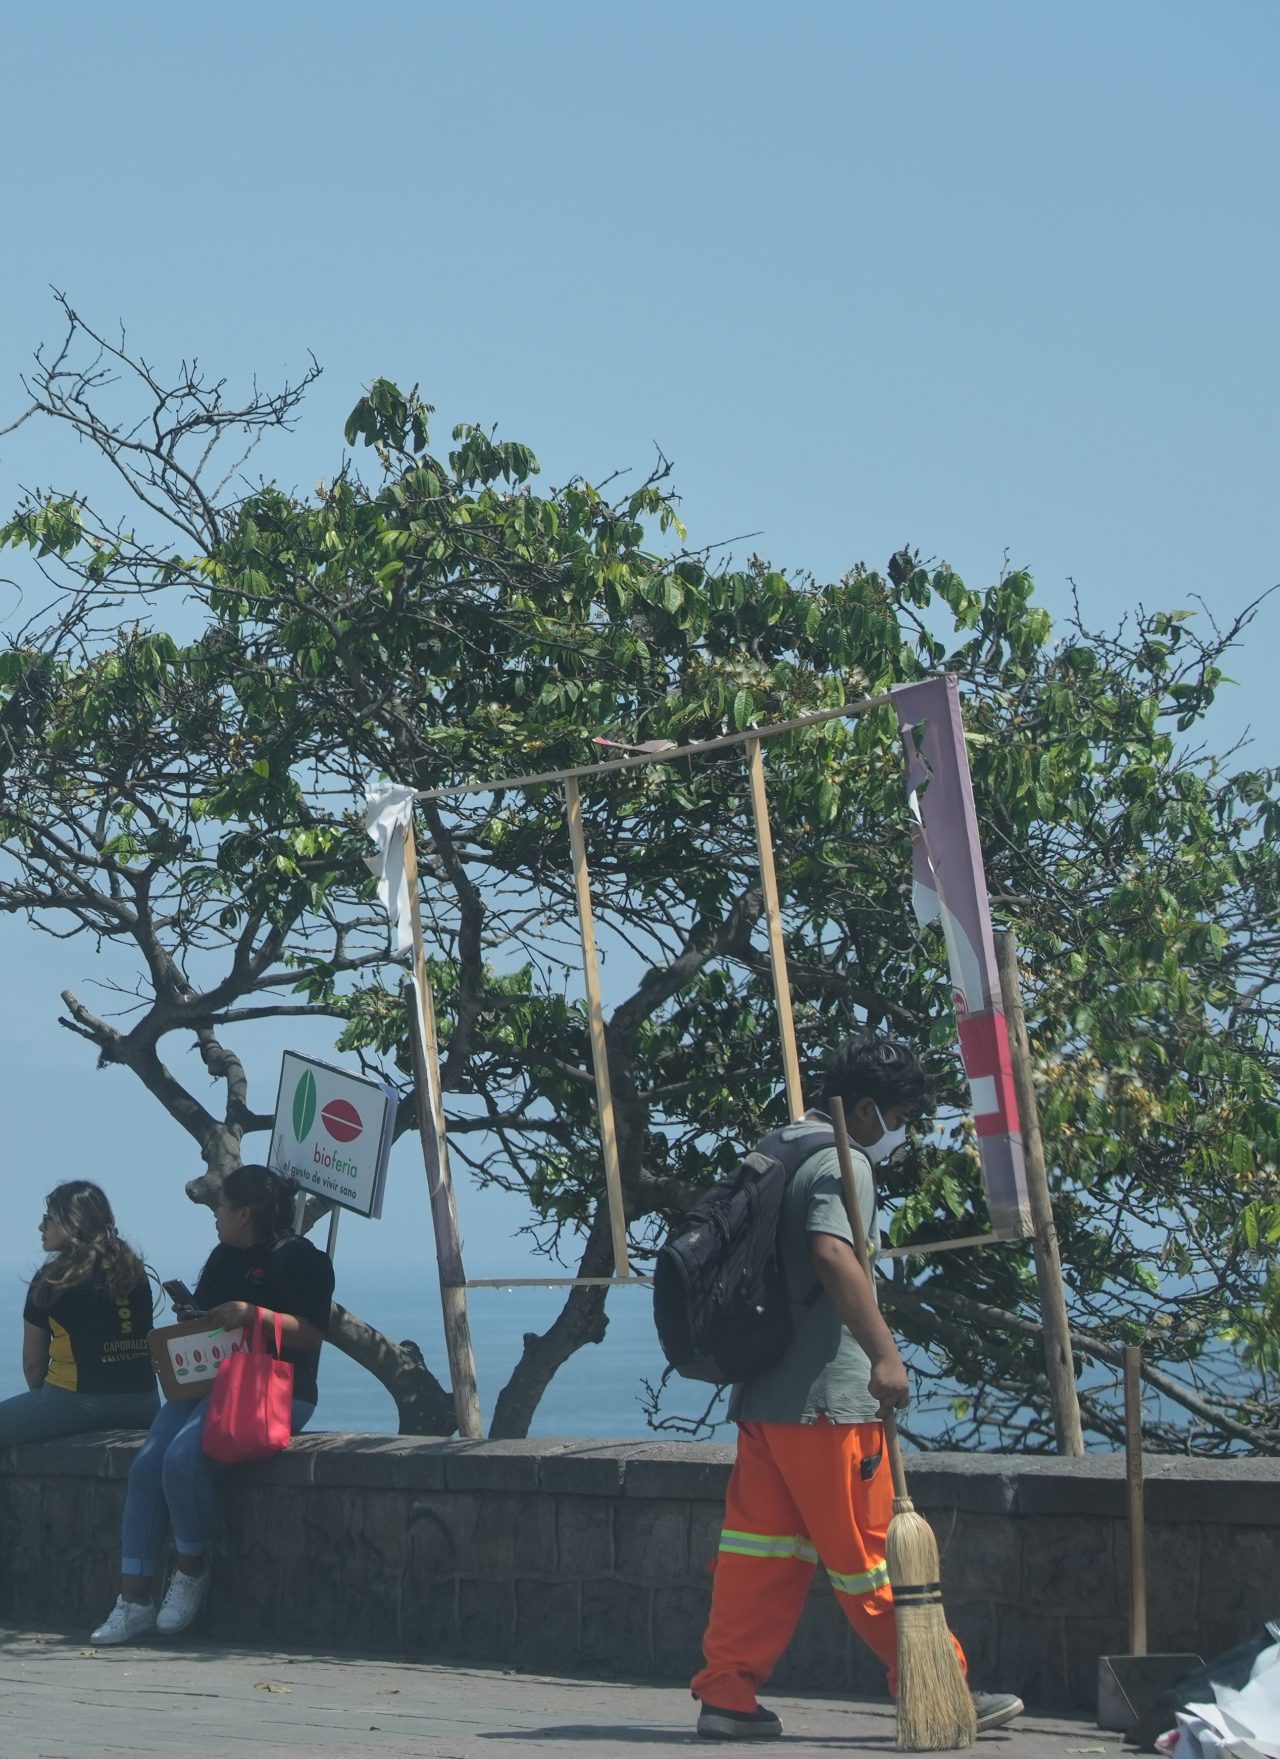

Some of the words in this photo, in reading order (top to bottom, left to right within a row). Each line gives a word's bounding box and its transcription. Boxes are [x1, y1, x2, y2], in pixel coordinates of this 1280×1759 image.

[313, 1142, 358, 1178] bioferia
[283, 1160, 290, 1172] el
[291, 1166, 310, 1180] gusto
[312, 1171, 320, 1184] de
[322, 1177, 338, 1191] vivir
[340, 1185, 357, 1199] sano
